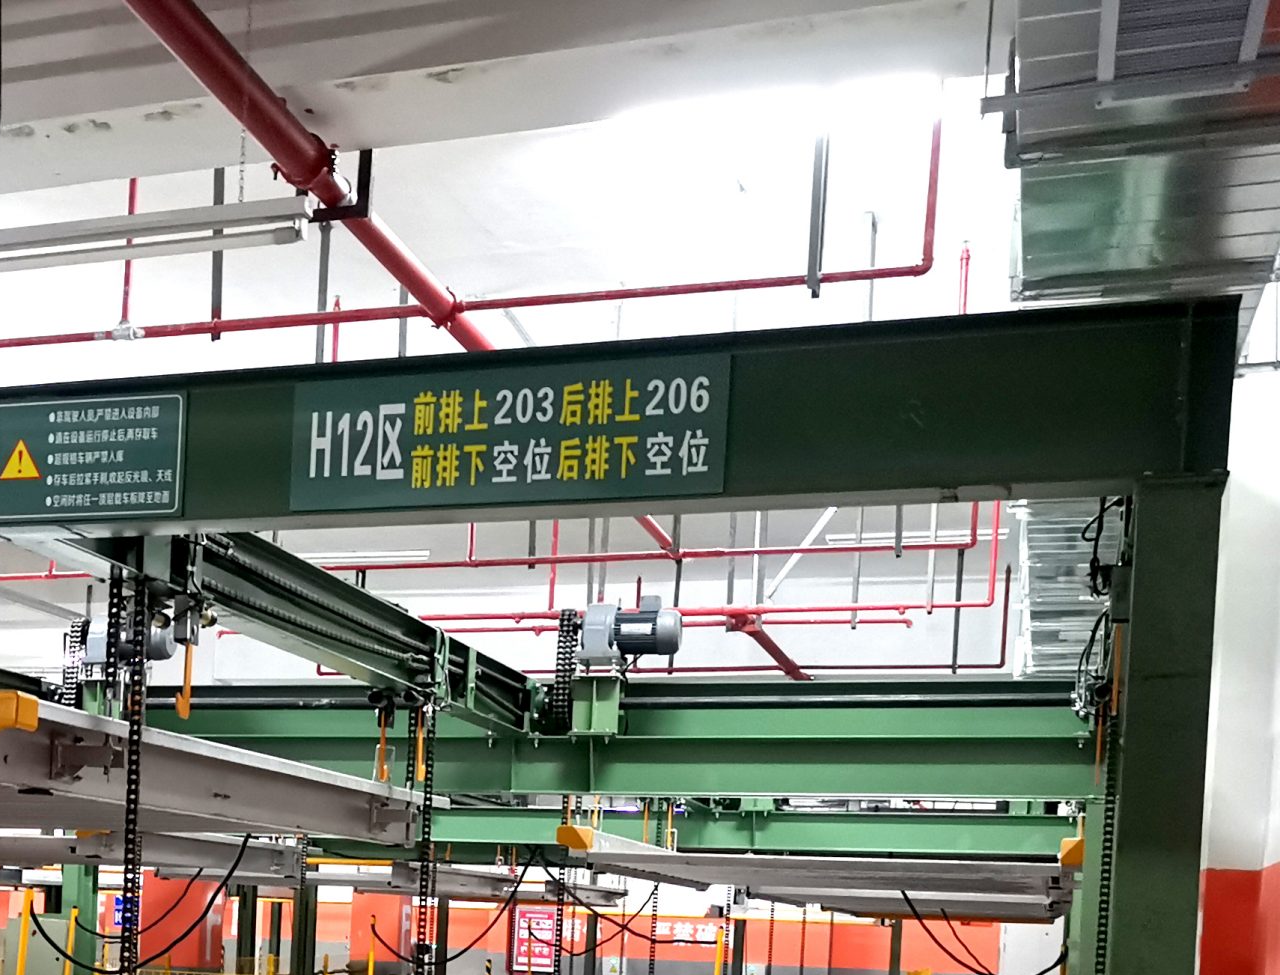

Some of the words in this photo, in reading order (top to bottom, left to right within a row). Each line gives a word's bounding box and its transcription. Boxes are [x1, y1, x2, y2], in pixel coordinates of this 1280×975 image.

[413, 375, 710, 436] 前排上203后排上206
[309, 403, 406, 480] H12区
[411, 429, 709, 489] 前排下空位后排下空位
